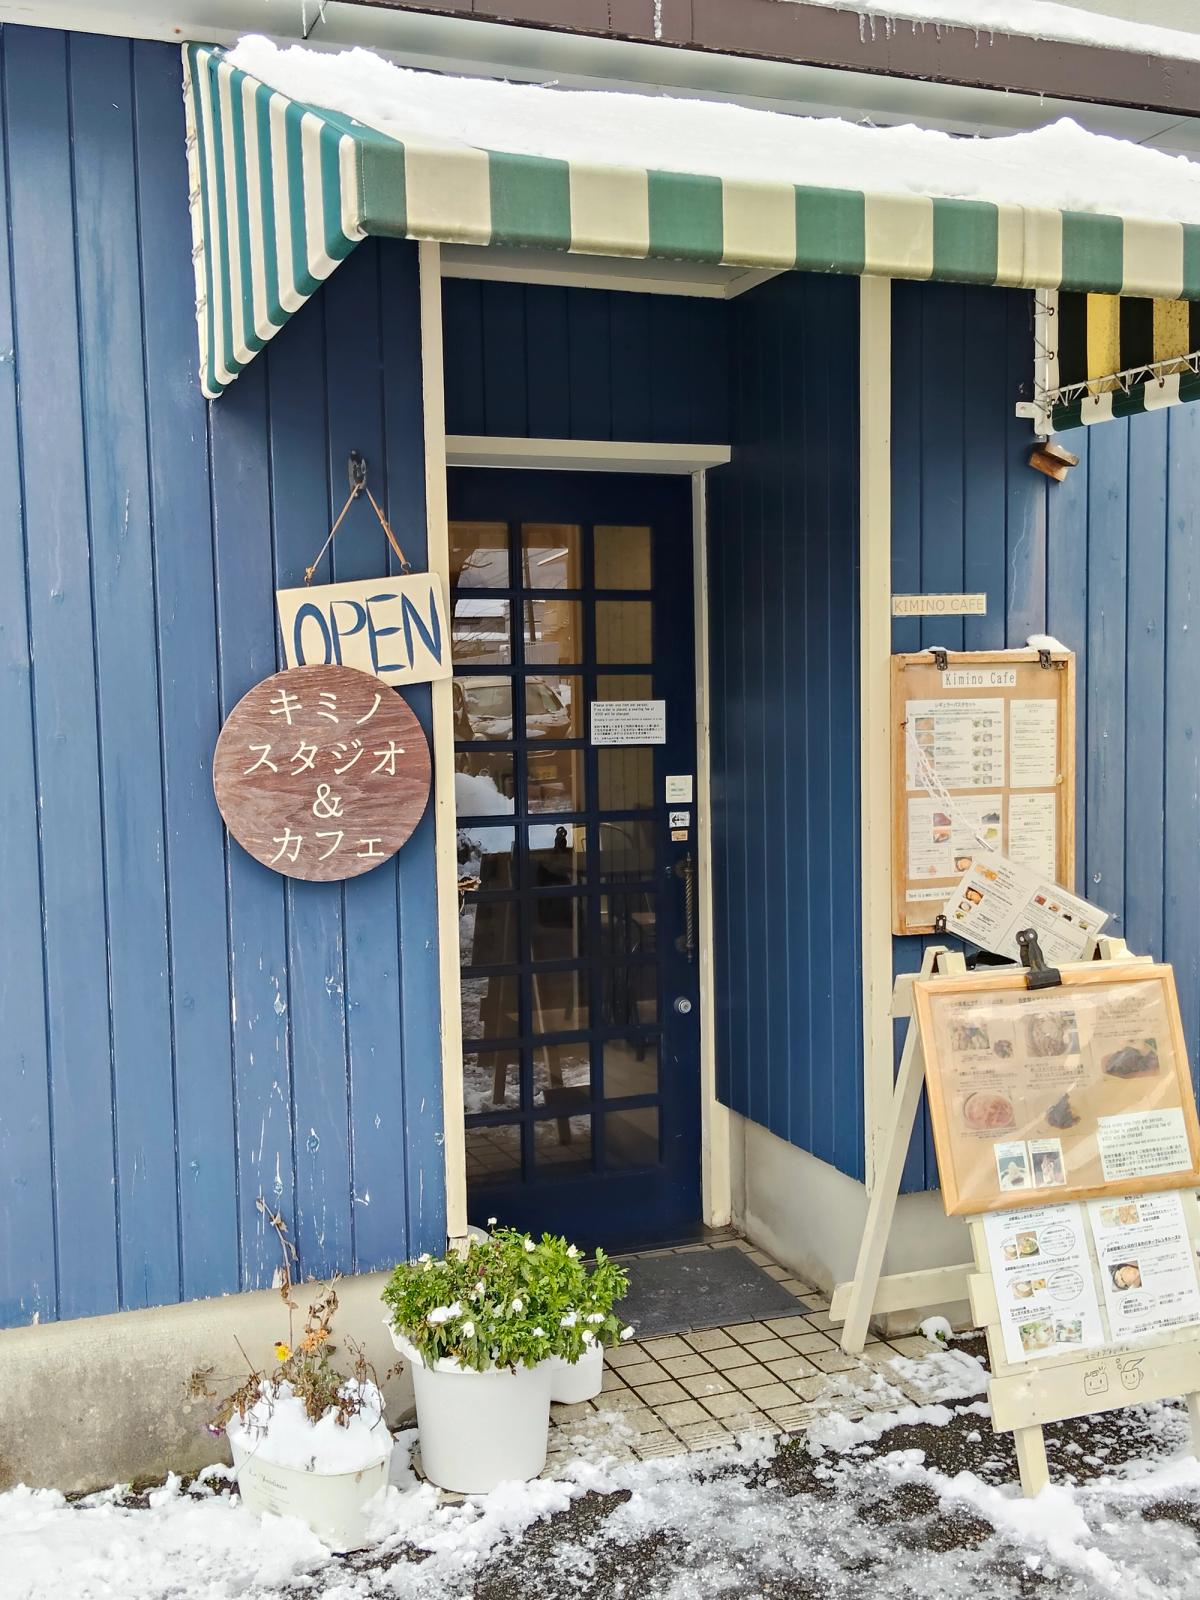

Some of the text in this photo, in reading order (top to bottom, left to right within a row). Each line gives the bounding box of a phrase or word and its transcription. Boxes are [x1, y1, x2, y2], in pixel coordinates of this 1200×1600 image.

[894, 598, 984, 612] KIMINO CAFE
[293, 586, 442, 676] OPEN
[945, 672, 1014, 686] Kimino Cafe
[269, 688, 381, 725] キミノ
[243, 740, 405, 777] スタジオ
[312, 783, 344, 818] &
[269, 827, 385, 863] カフェ
